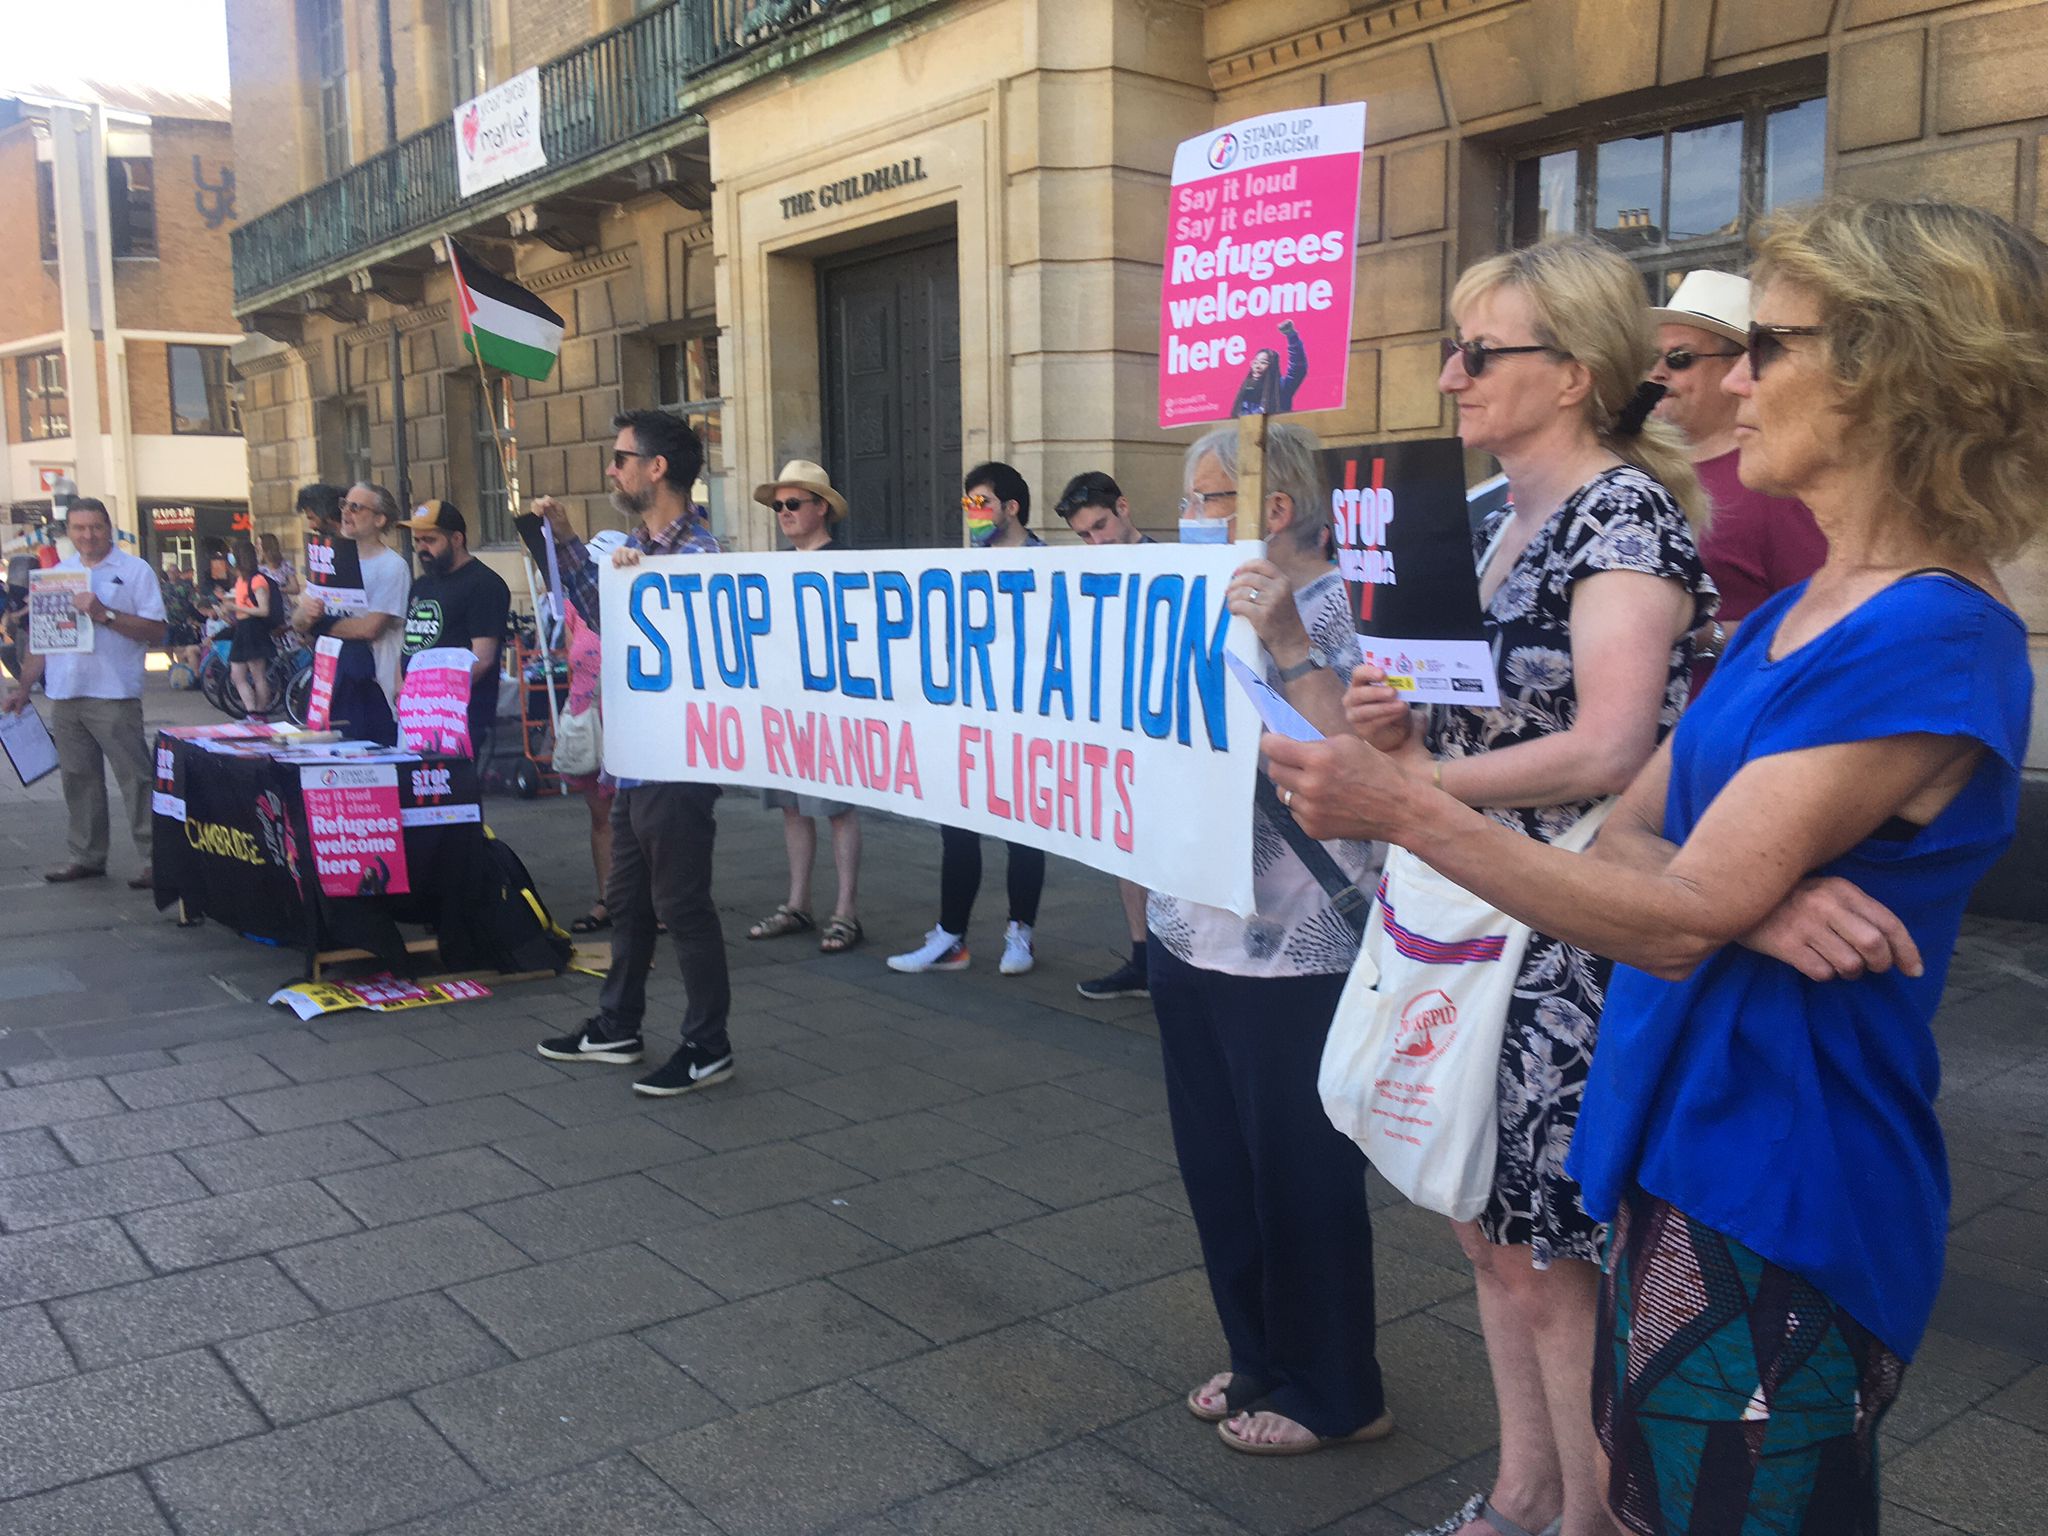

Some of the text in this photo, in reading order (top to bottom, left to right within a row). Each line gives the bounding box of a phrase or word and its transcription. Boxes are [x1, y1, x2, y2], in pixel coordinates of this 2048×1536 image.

[1242, 119, 1313, 145] STAND UP
[1242, 134, 1319, 161] TO RACISM
[779, 155, 928, 220] THE GUILDHALL
[1178, 166, 1299, 214] Say it loud
[1175, 199, 1313, 242] Say it clear:
[1171, 230, 1345, 285] Refugees
[1169, 279, 1334, 329] welcome
[1167, 334, 1247, 375] here
[1332, 487, 1395, 547] STOP
[307, 543, 335, 565] STOP
[627, 567, 1231, 753] STOP DEPORTATION
[307, 788, 372, 803] Say it loud
[411, 768, 451, 788] STOP
[685, 701, 1136, 854] NO RWANDA FLIGHTS
[309, 803, 333, 816] Say
[335, 802, 346, 814] it
[311, 815, 399, 838] Refugees
[185, 816, 267, 866] CAMBRIDGE
[314, 834, 397, 856] welcome
[316, 855, 361, 875] here
